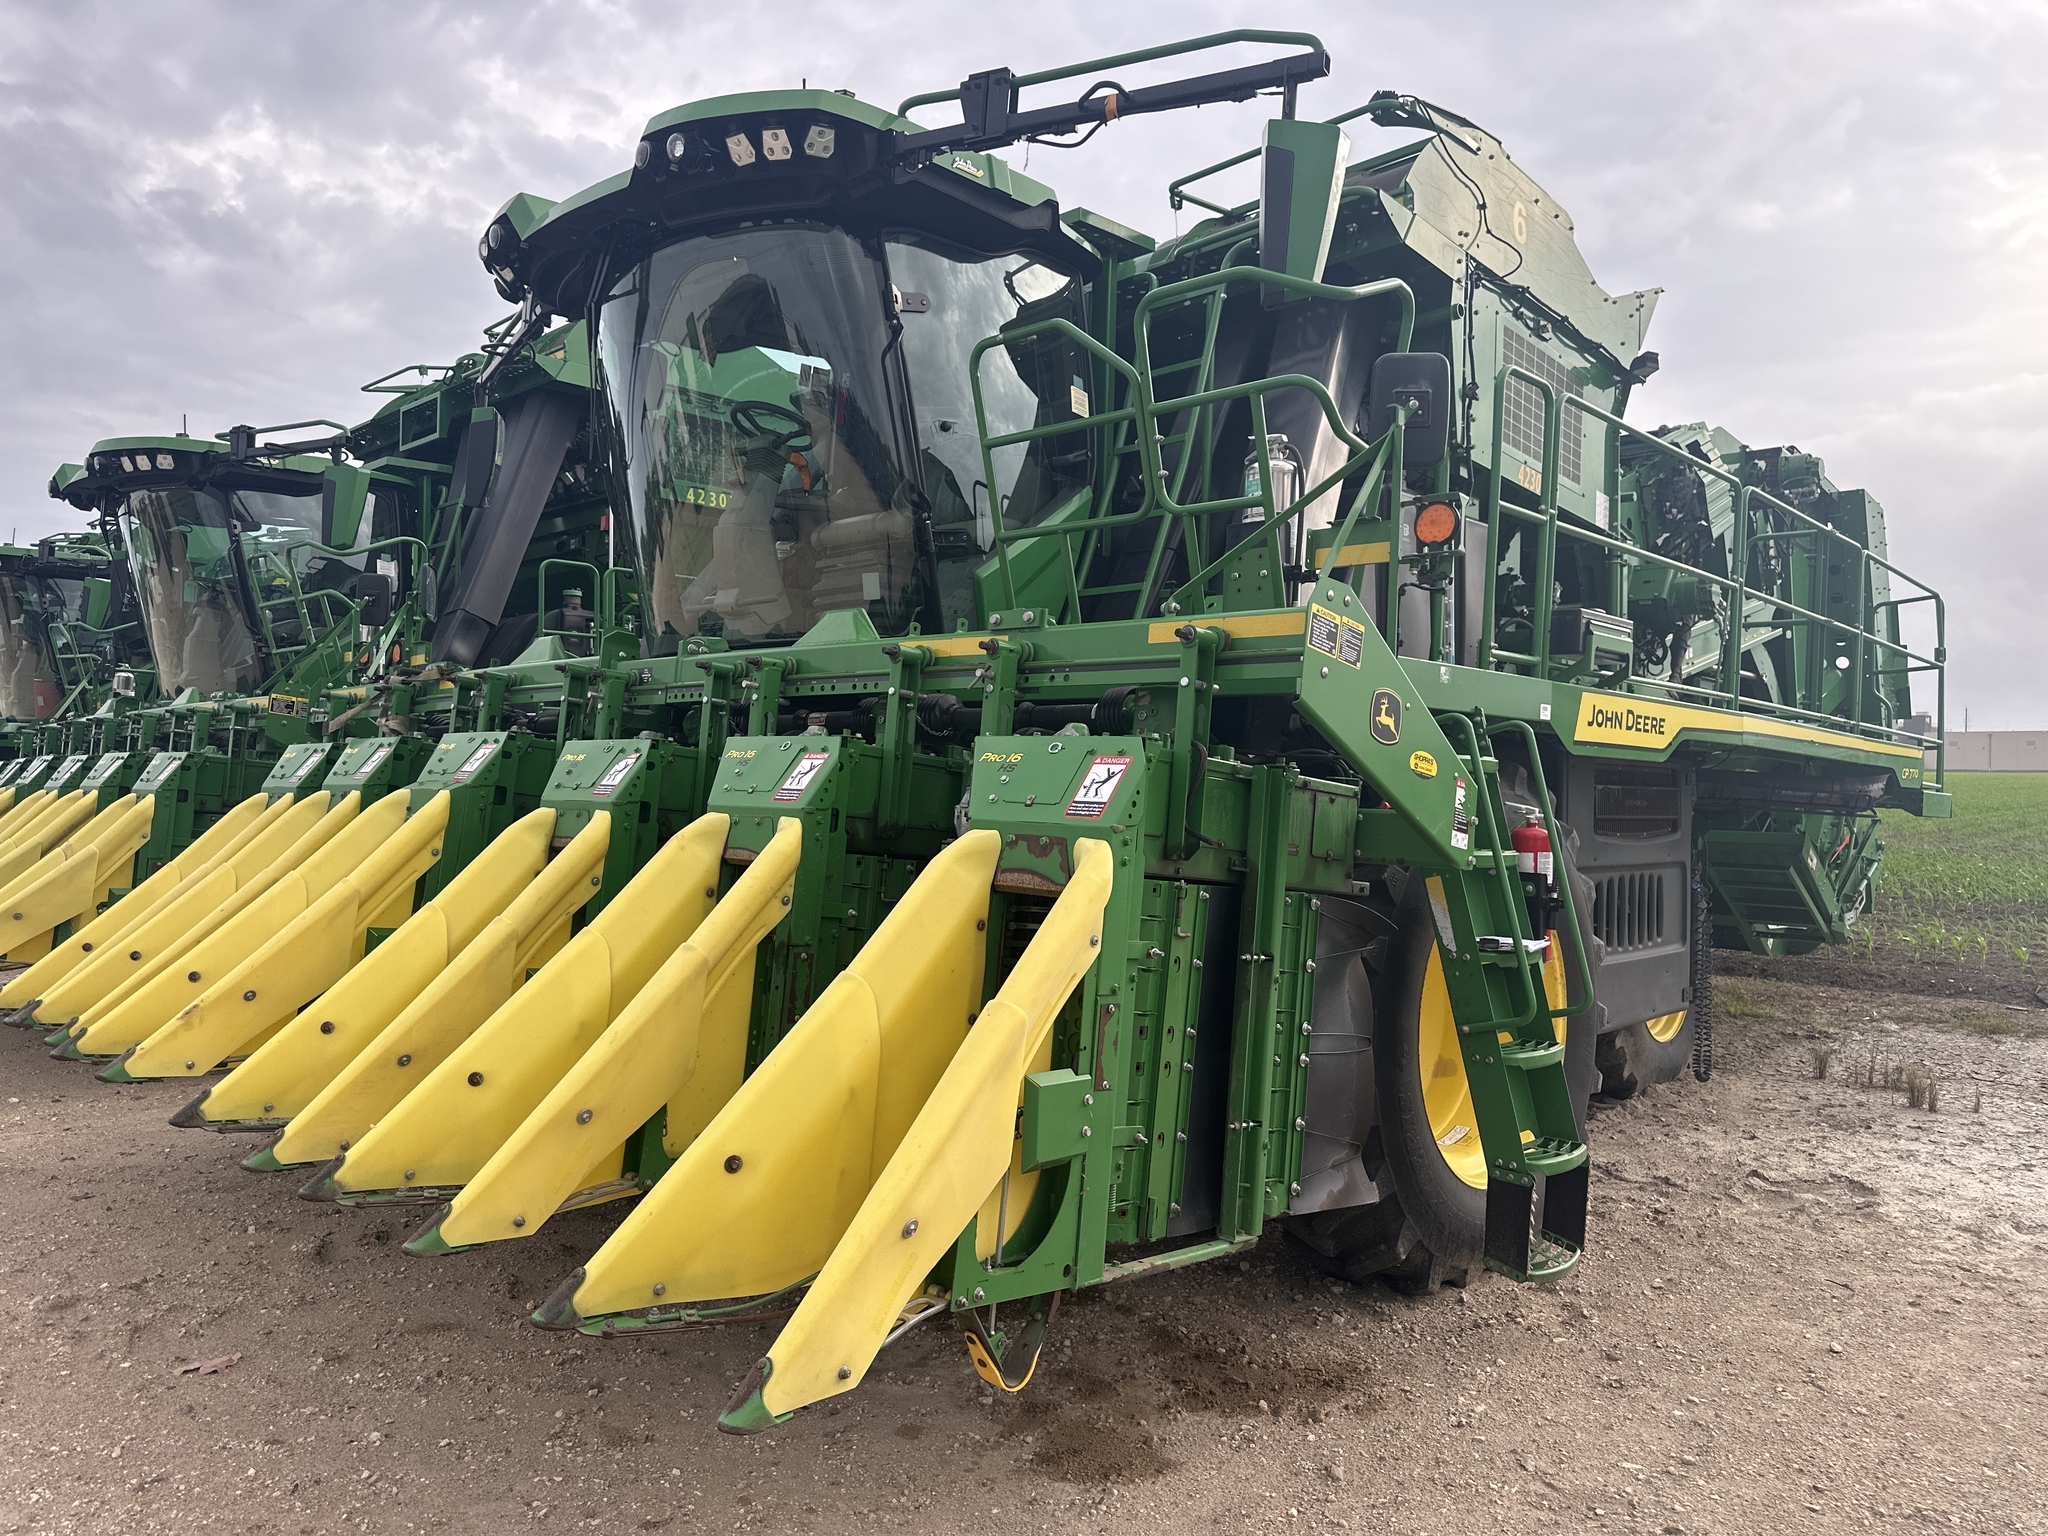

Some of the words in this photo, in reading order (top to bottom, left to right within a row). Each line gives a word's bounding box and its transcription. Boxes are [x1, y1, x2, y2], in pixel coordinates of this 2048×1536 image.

[1513, 201, 1527, 245] 6
[1518, 464, 1542, 493] 4230
[687, 488, 727, 508] 4230
[1587, 704, 1623, 730] JOHN
[1625, 709, 1666, 735] DEERE
[743, 749, 757, 758] 16
[979, 752, 1007, 762] PRO
[1006, 752, 1024, 763] 16
[997, 763, 1018, 773] HS
